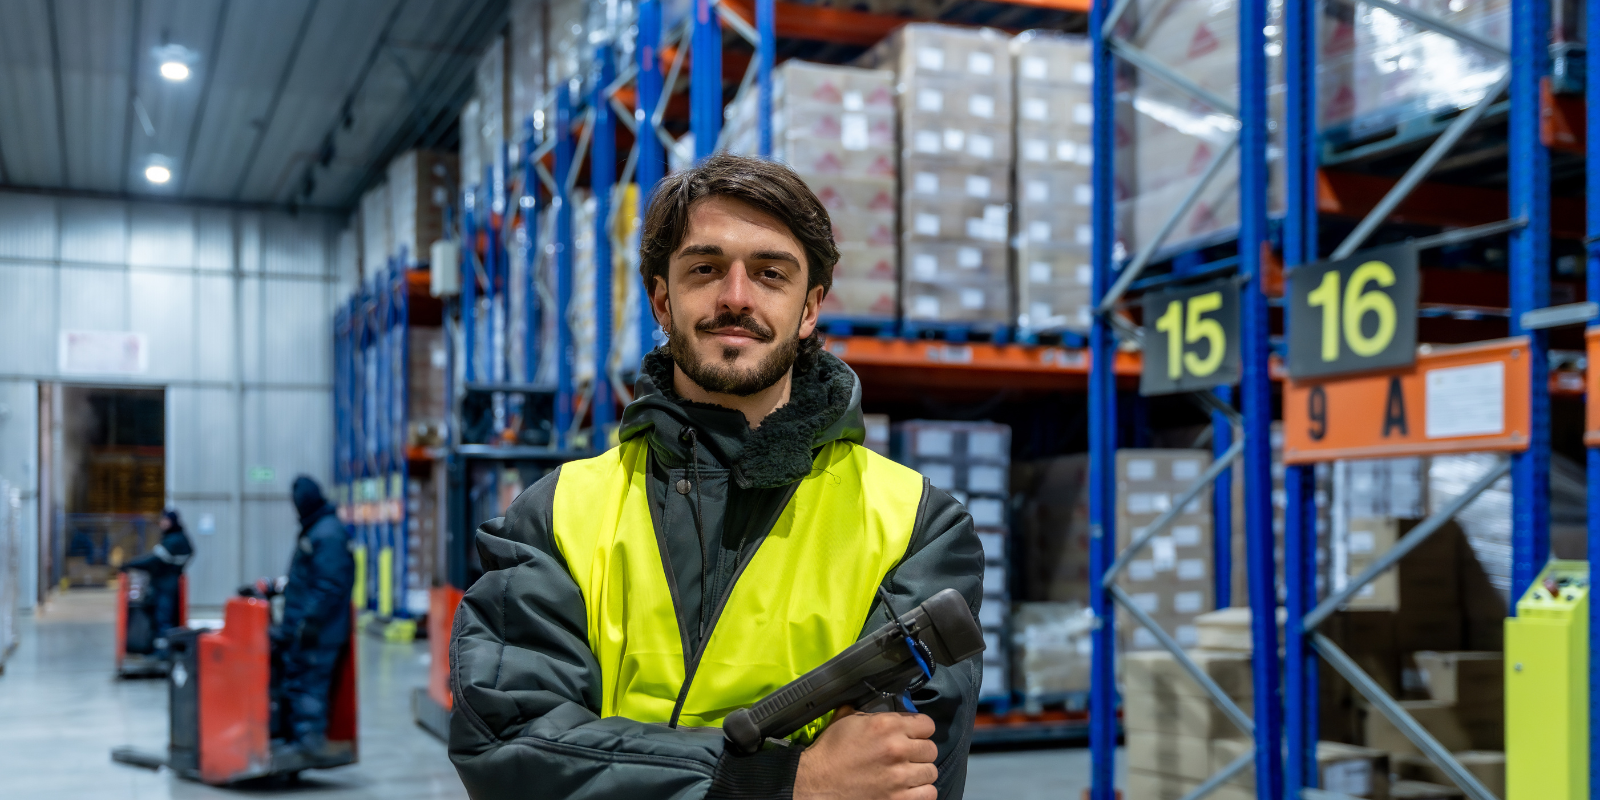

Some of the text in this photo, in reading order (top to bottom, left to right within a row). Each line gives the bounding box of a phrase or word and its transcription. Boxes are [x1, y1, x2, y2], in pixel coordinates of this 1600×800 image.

[1156, 291, 1226, 379] 15
[1307, 260, 1397, 362] 16
[1308, 385, 1327, 441] 9
[1382, 375, 1408, 438] A
